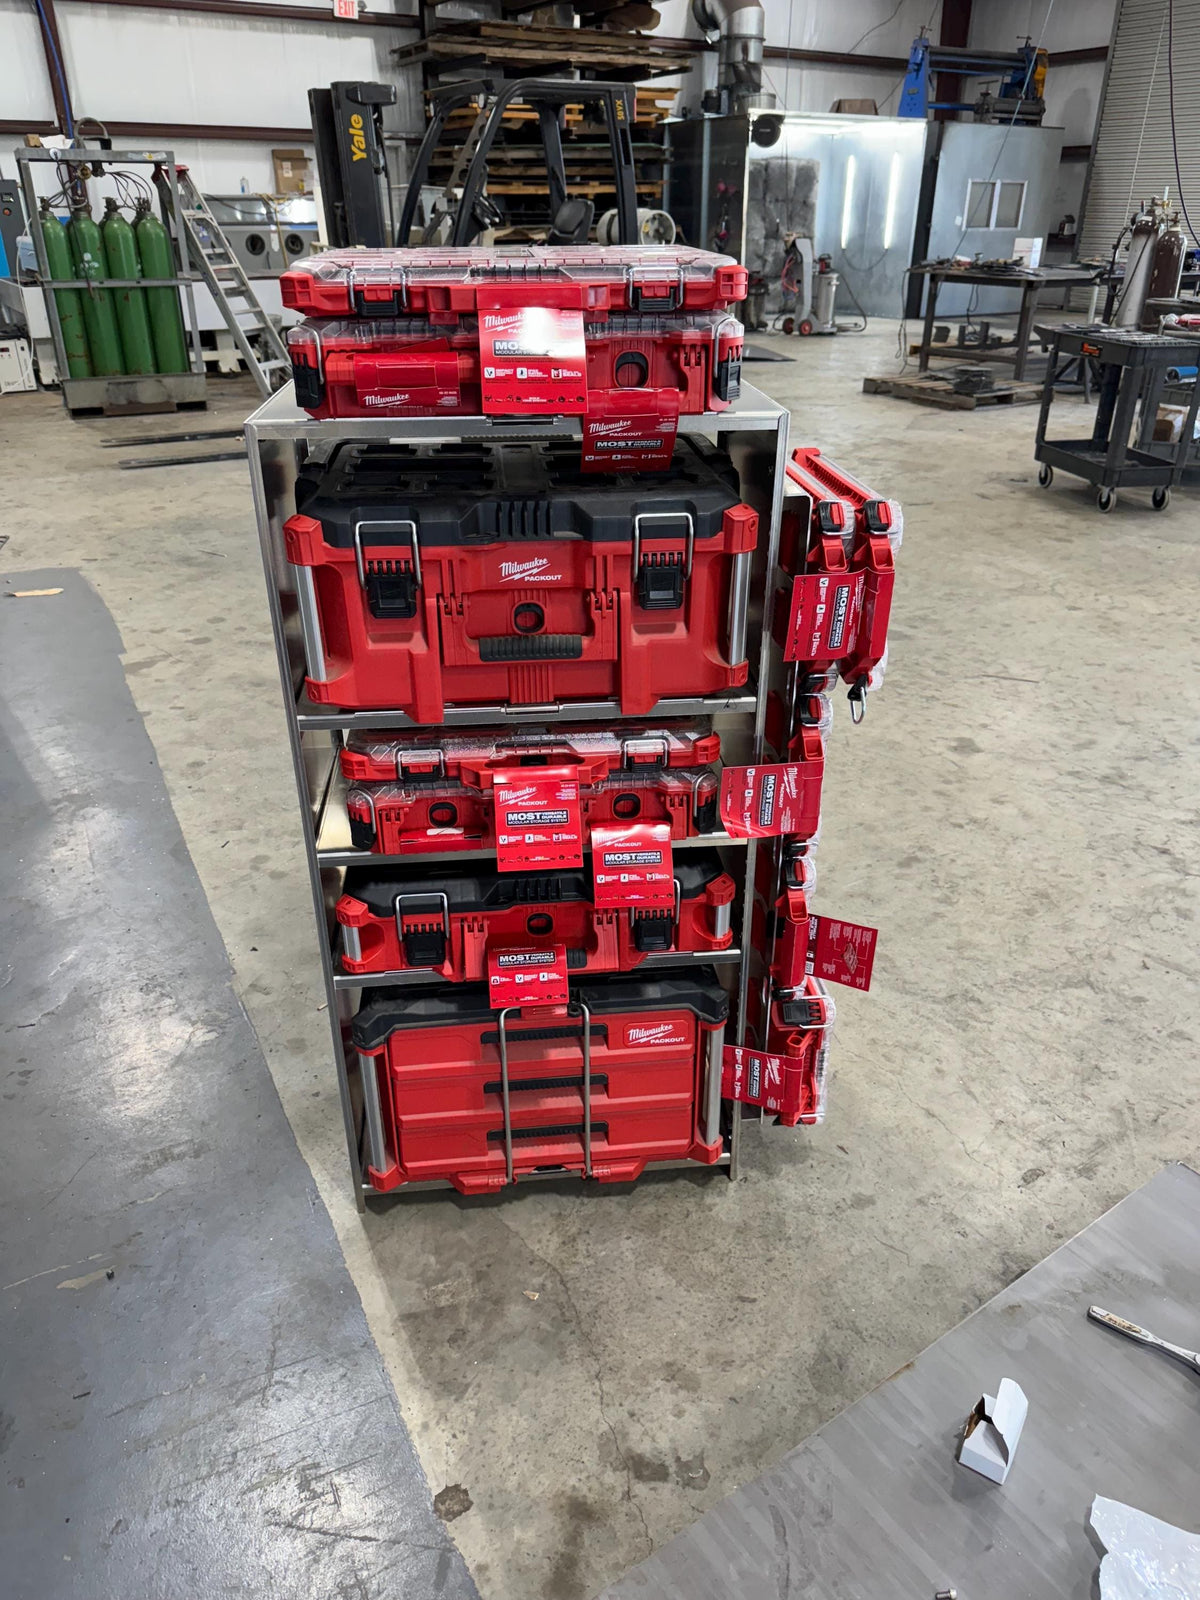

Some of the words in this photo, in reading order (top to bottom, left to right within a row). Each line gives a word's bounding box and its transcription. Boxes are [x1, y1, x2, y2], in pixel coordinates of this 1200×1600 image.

[337, 0, 355, 17] EXIT
[349, 114, 367, 161] Yale
[363, 393, 410, 406] Milwaukee
[588, 420, 632, 433] Milwaukee
[498, 557, 549, 577] Milwaukee
[838, 587, 849, 622] MOST
[766, 775, 775, 804] MOST
[787, 766, 798, 799] Milwaukee
[499, 786, 537, 802] Milwaukee
[508, 812, 541, 820] MOST
[605, 853, 636, 861] MOST
[500, 954, 531, 962] MOST
[627, 1024, 674, 1041] Milwaukee
